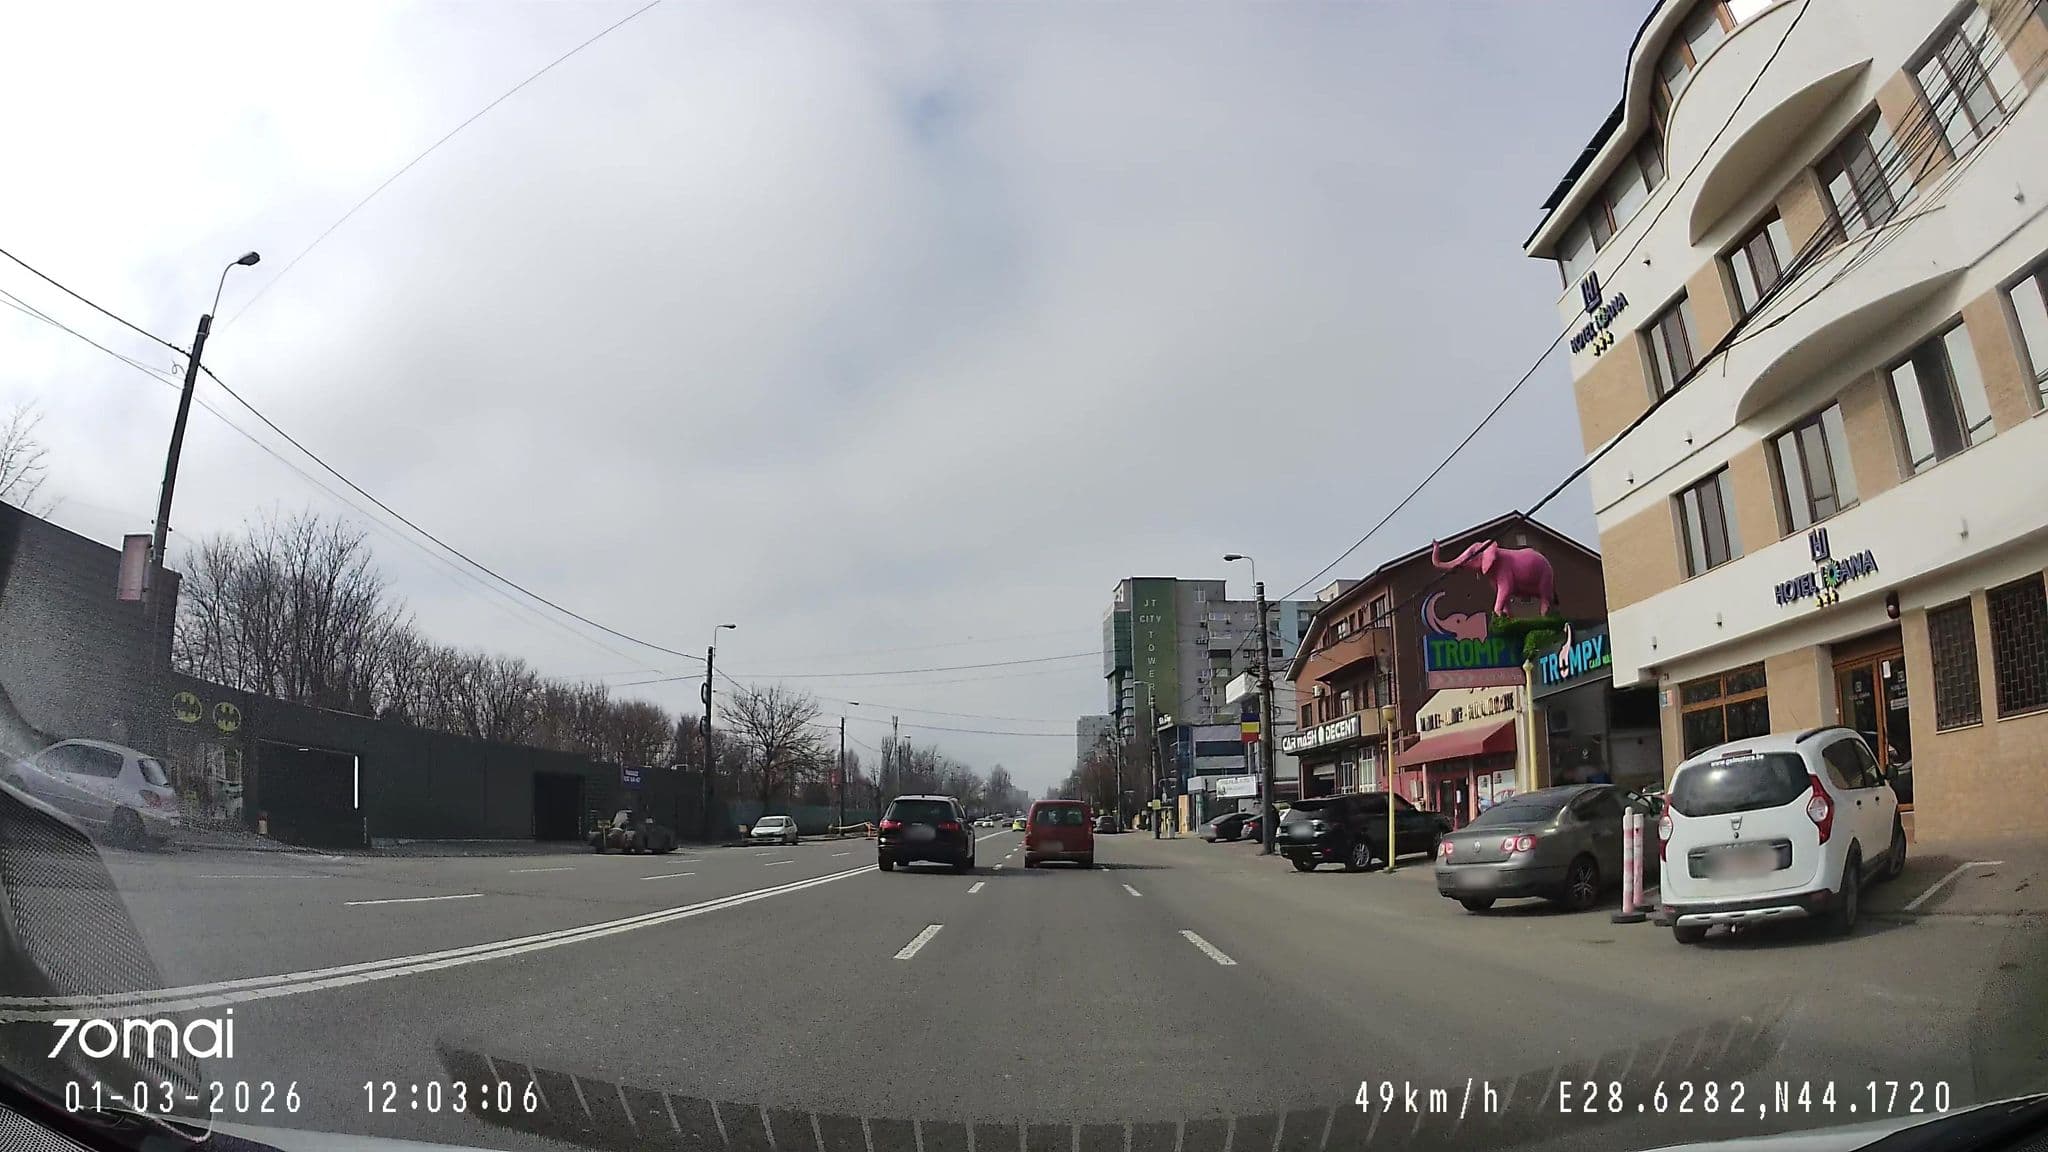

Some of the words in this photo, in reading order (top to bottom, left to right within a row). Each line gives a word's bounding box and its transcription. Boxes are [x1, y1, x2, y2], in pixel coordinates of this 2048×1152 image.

[1774, 571, 1820, 608] HOTEL
[1139, 615, 1161, 623] CITY
[1282, 736, 1297, 752] CAR
[1325, 717, 1357, 742] DECENT
